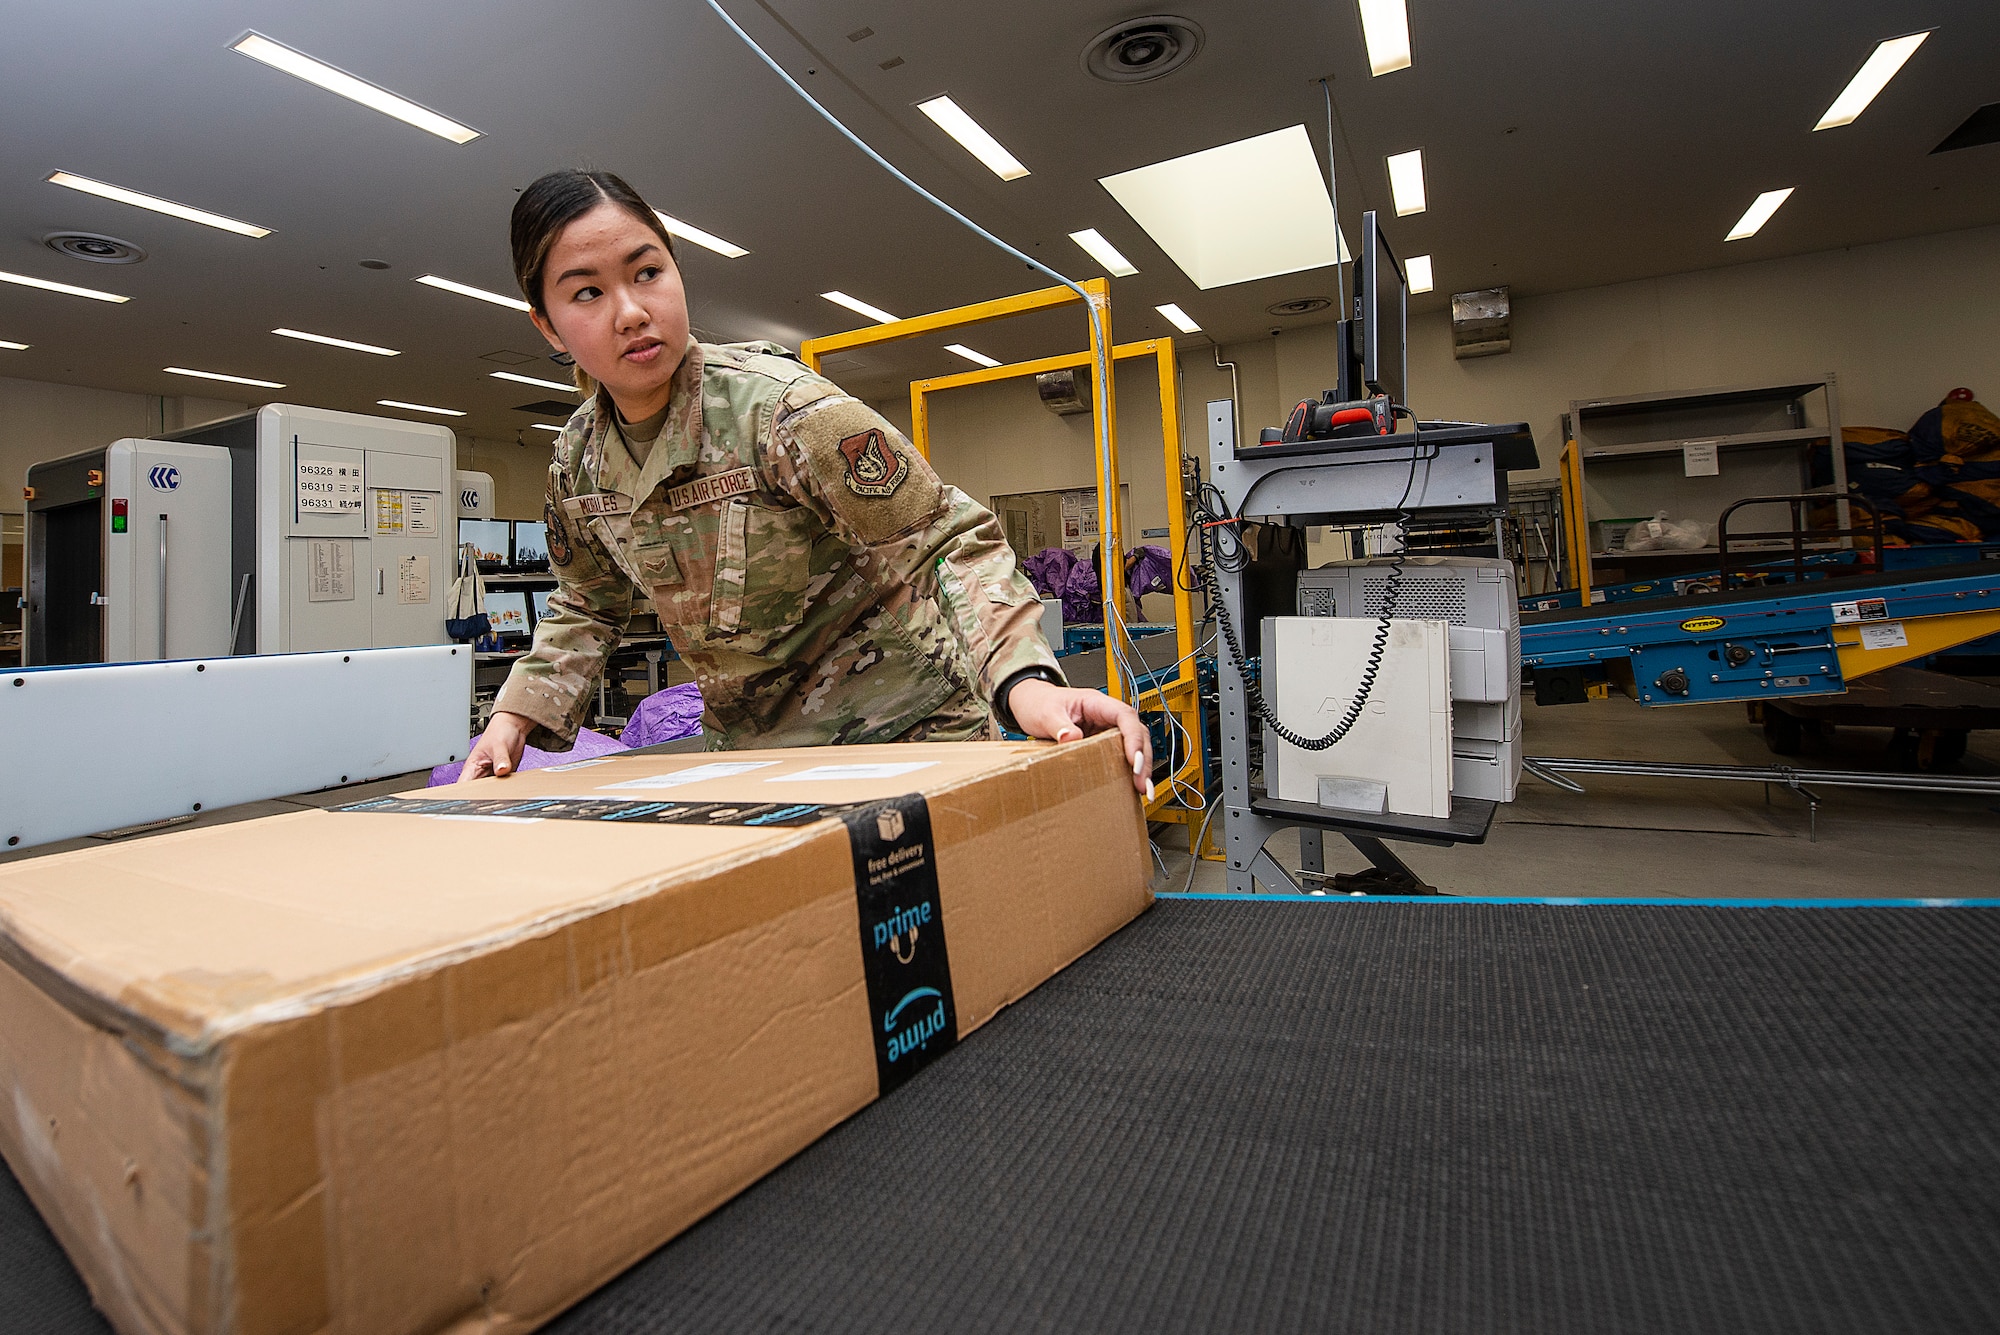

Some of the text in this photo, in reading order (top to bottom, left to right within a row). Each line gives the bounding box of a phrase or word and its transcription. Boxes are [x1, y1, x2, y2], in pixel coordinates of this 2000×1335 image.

[300, 465, 333, 475] 96326
[301, 482, 333, 491] 96319
[711, 471, 751, 498] FORCE
[301, 499, 334, 507] 96331
[1685, 620, 1721, 629] HYTROL
[868, 843, 924, 875] free delivery
[873, 900, 932, 951] prime
[887, 1000, 947, 1063] prime
